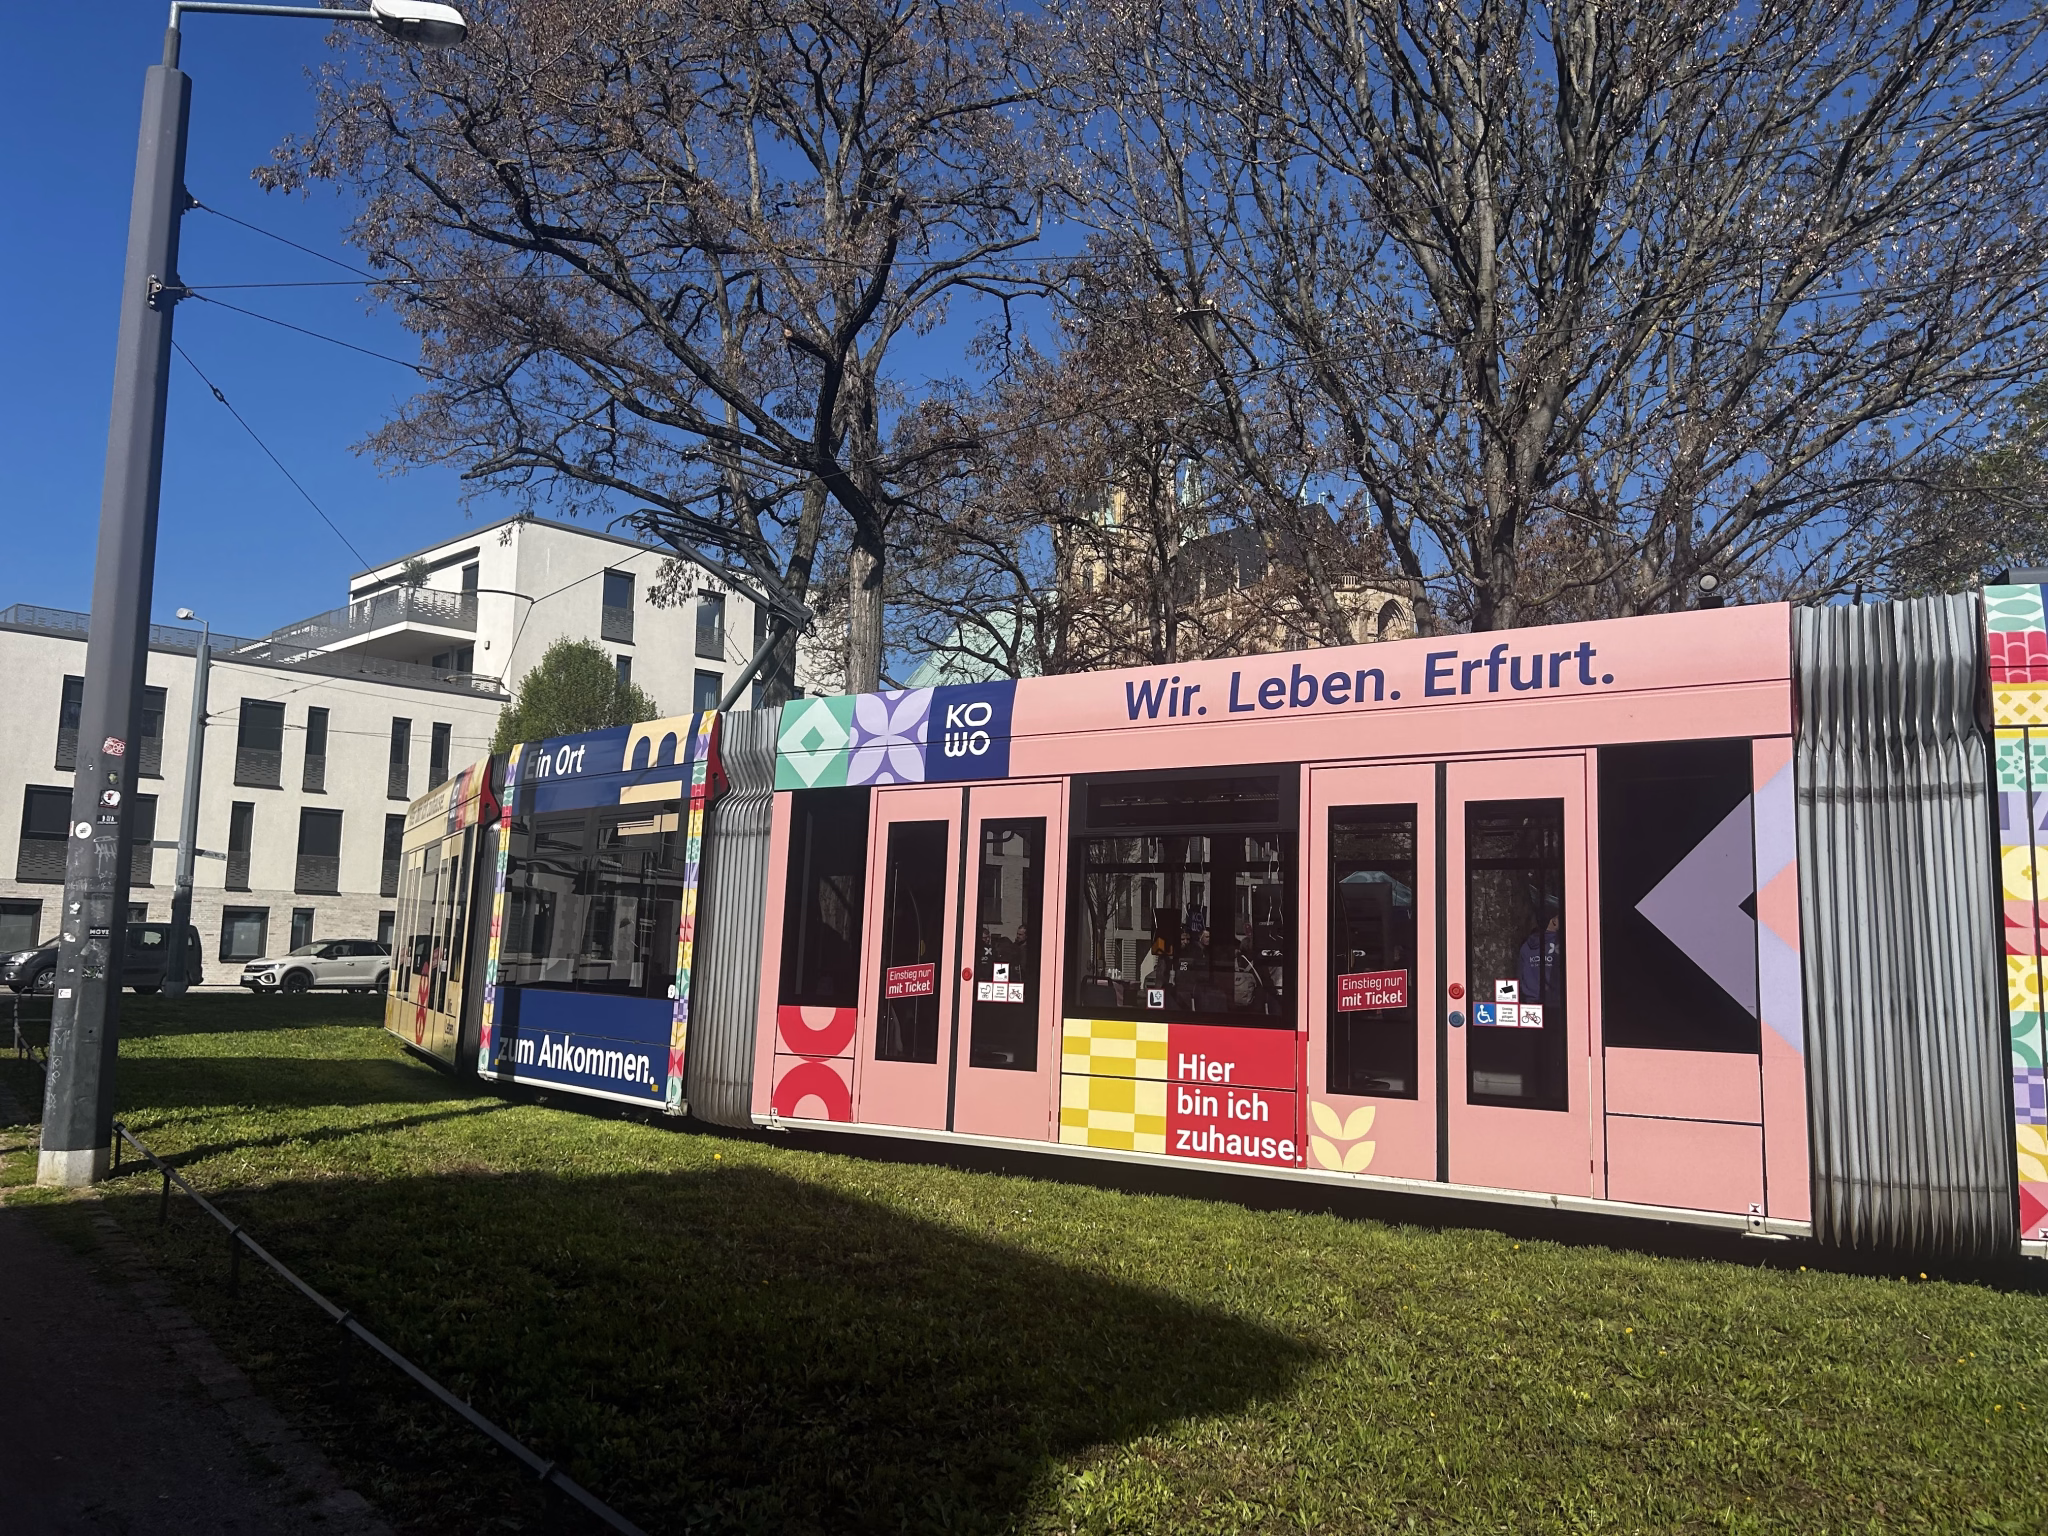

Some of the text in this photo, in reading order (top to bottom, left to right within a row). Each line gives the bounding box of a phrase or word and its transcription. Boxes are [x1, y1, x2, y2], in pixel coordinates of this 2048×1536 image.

[1125, 642, 1615, 720] Wir. Leben. Erfurt.
[946, 702, 992, 728] KO
[944, 730, 990, 758] WO
[524, 744, 586, 780] Ein Ort
[888, 980, 931, 995] mit Ticket
[889, 969, 932, 982] Einstieg nur
[1342, 976, 1402, 991] Einstieg nur
[1342, 990, 1403, 1007] mit Ticket
[498, 1034, 655, 1084] zum Ankommen.
[1178, 1053, 1235, 1082] Hier
[1178, 1086, 1268, 1122] bin ich
[1176, 1124, 1303, 1162] zuhause.
